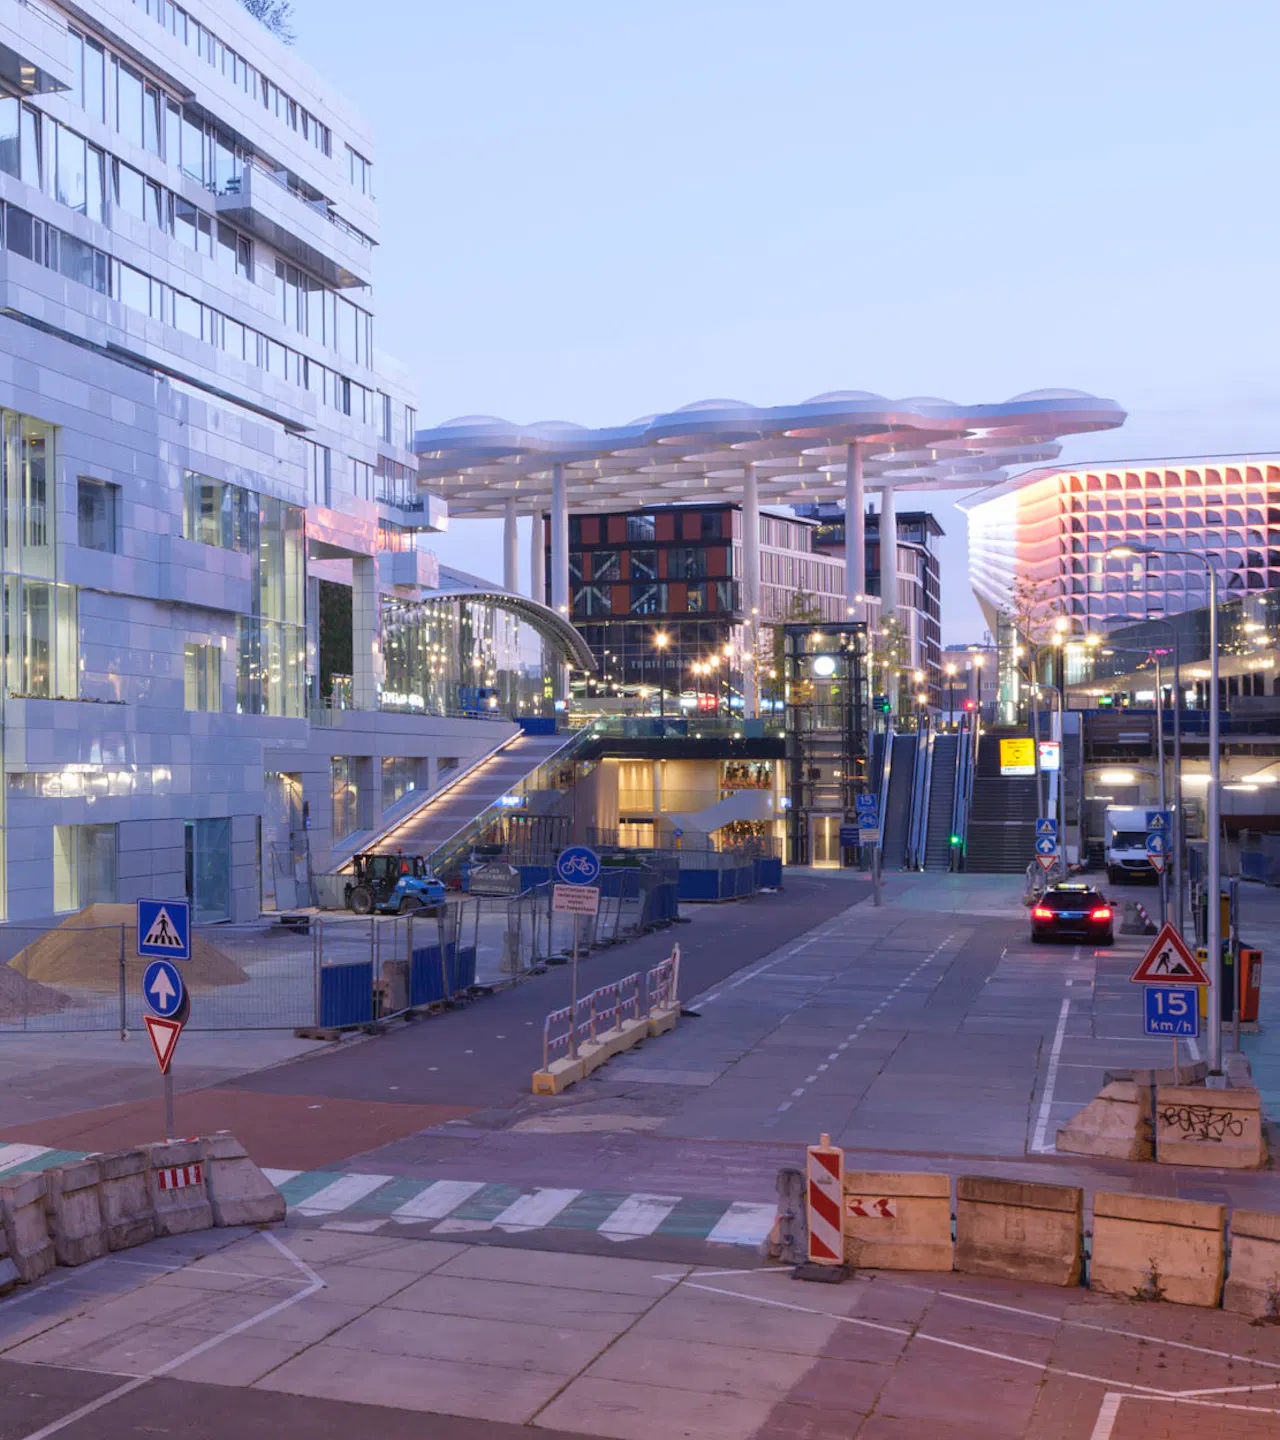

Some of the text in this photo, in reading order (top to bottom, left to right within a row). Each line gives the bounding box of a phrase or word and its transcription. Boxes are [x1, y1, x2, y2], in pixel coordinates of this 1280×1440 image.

[860, 795, 873, 805] 15
[1153, 992, 1188, 1016] 15
[1150, 1018, 1193, 1033] km/h
